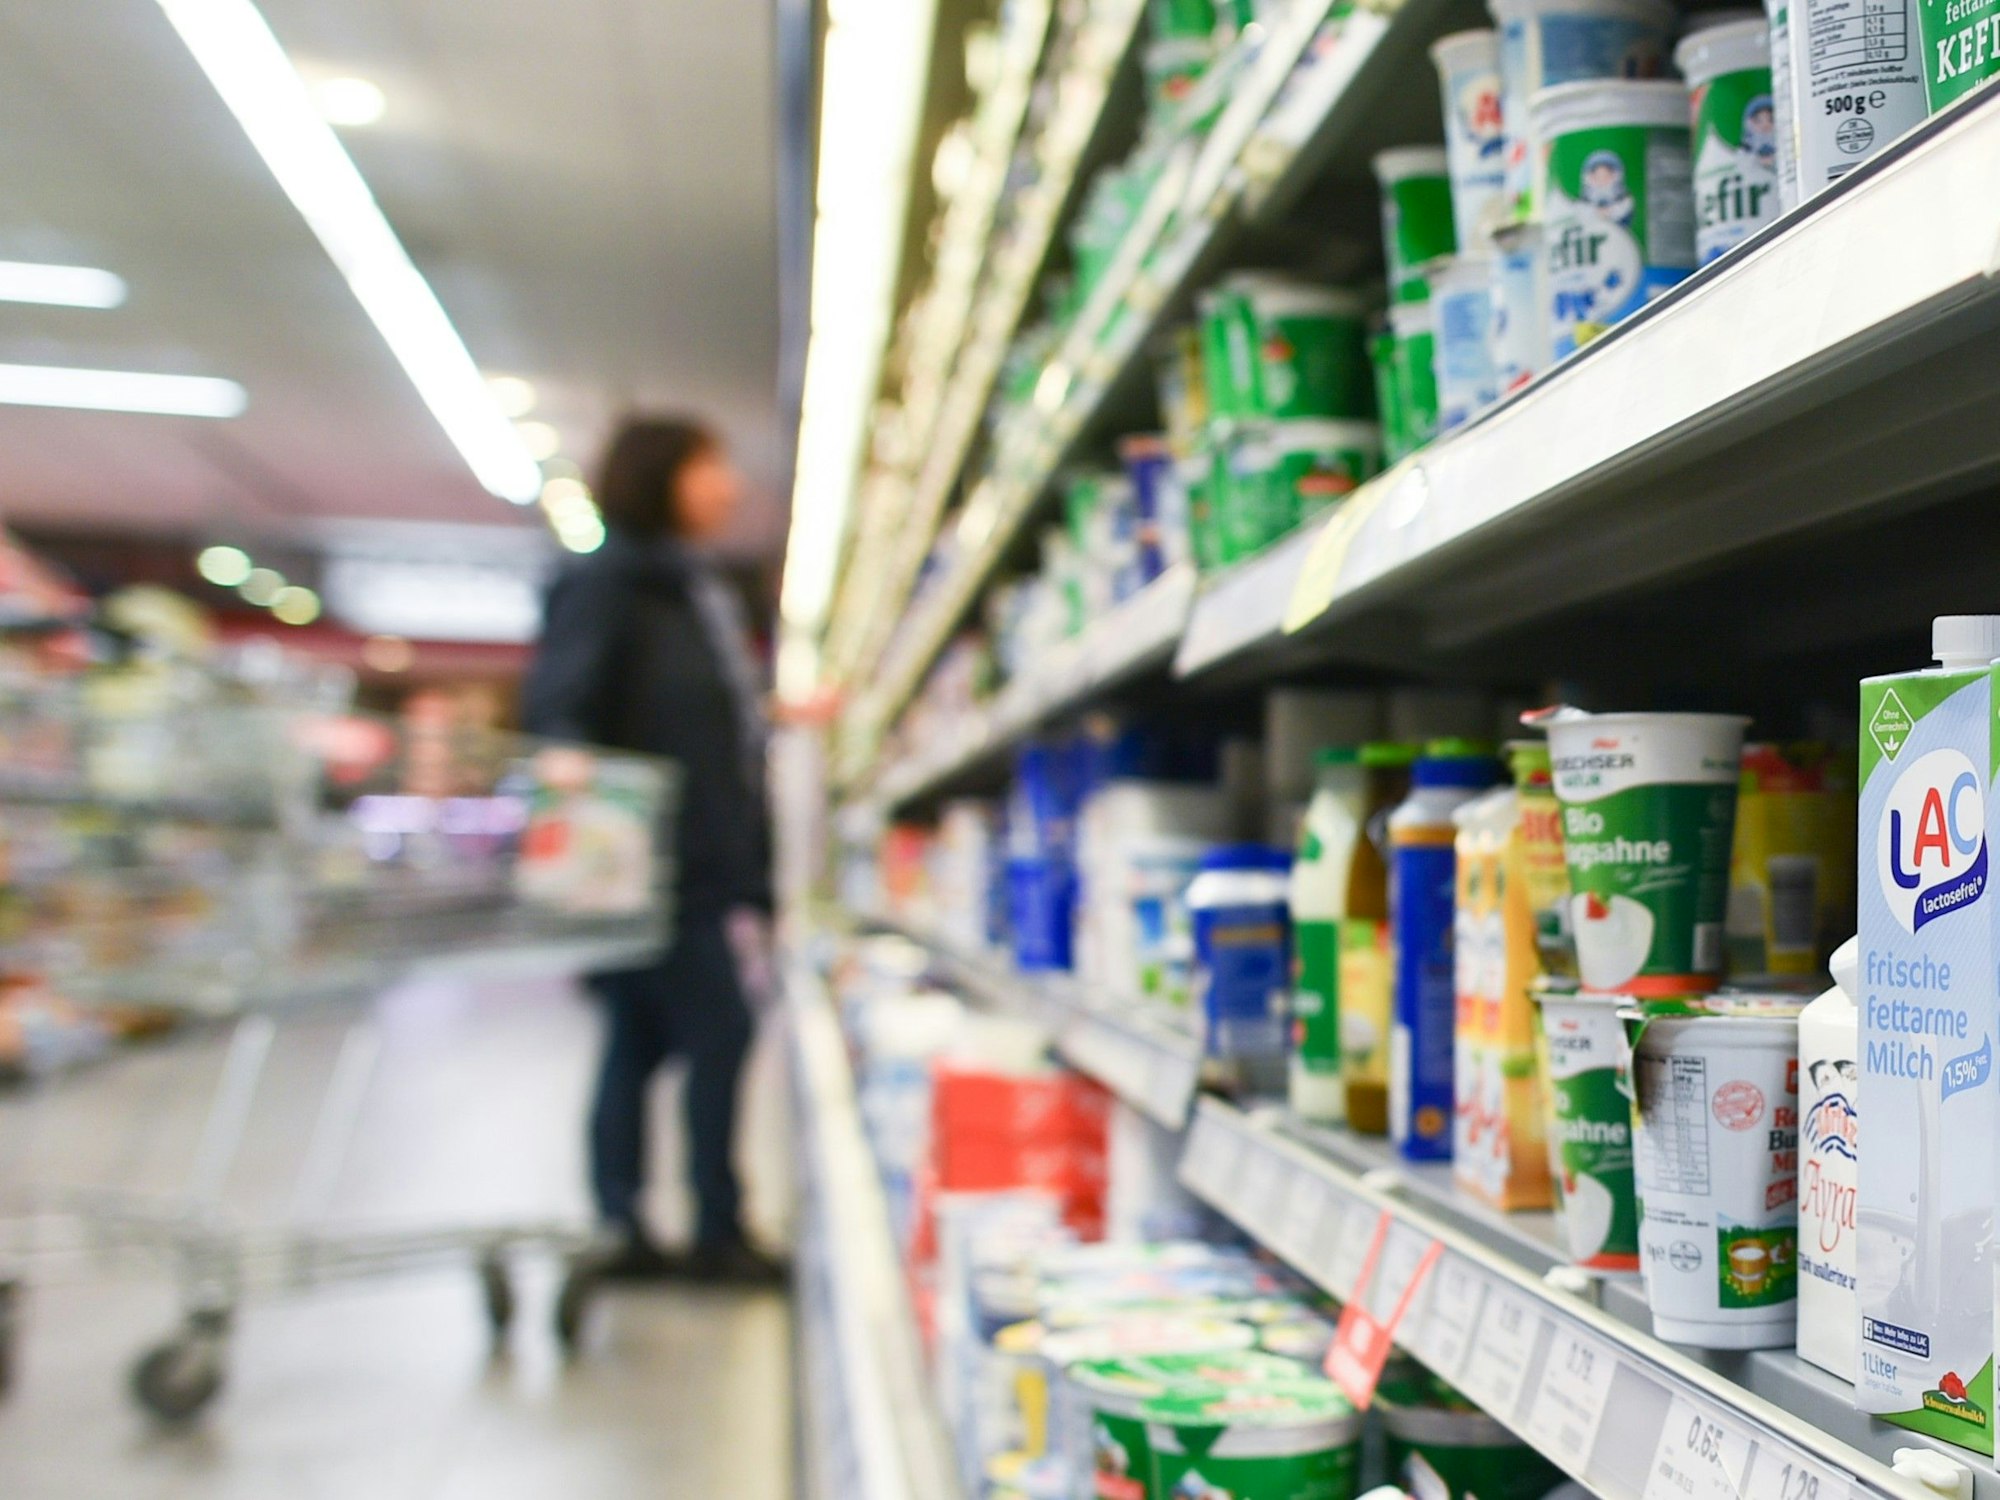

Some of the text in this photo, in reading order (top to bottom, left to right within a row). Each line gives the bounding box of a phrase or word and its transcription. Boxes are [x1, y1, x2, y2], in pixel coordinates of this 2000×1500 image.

[1946, 0, 1996, 25] fettar
[1883, 710, 1899, 720] Ohne
[1890, 771, 1978, 889] LAC
[1867, 950, 1950, 991] frische
[1867, 995, 1968, 1039] fettarme
[1867, 1040, 1933, 1081] Milch
[1945, 1060, 1977, 1088] 1,5%
[1801, 1160, 1857, 1253] Ayra
